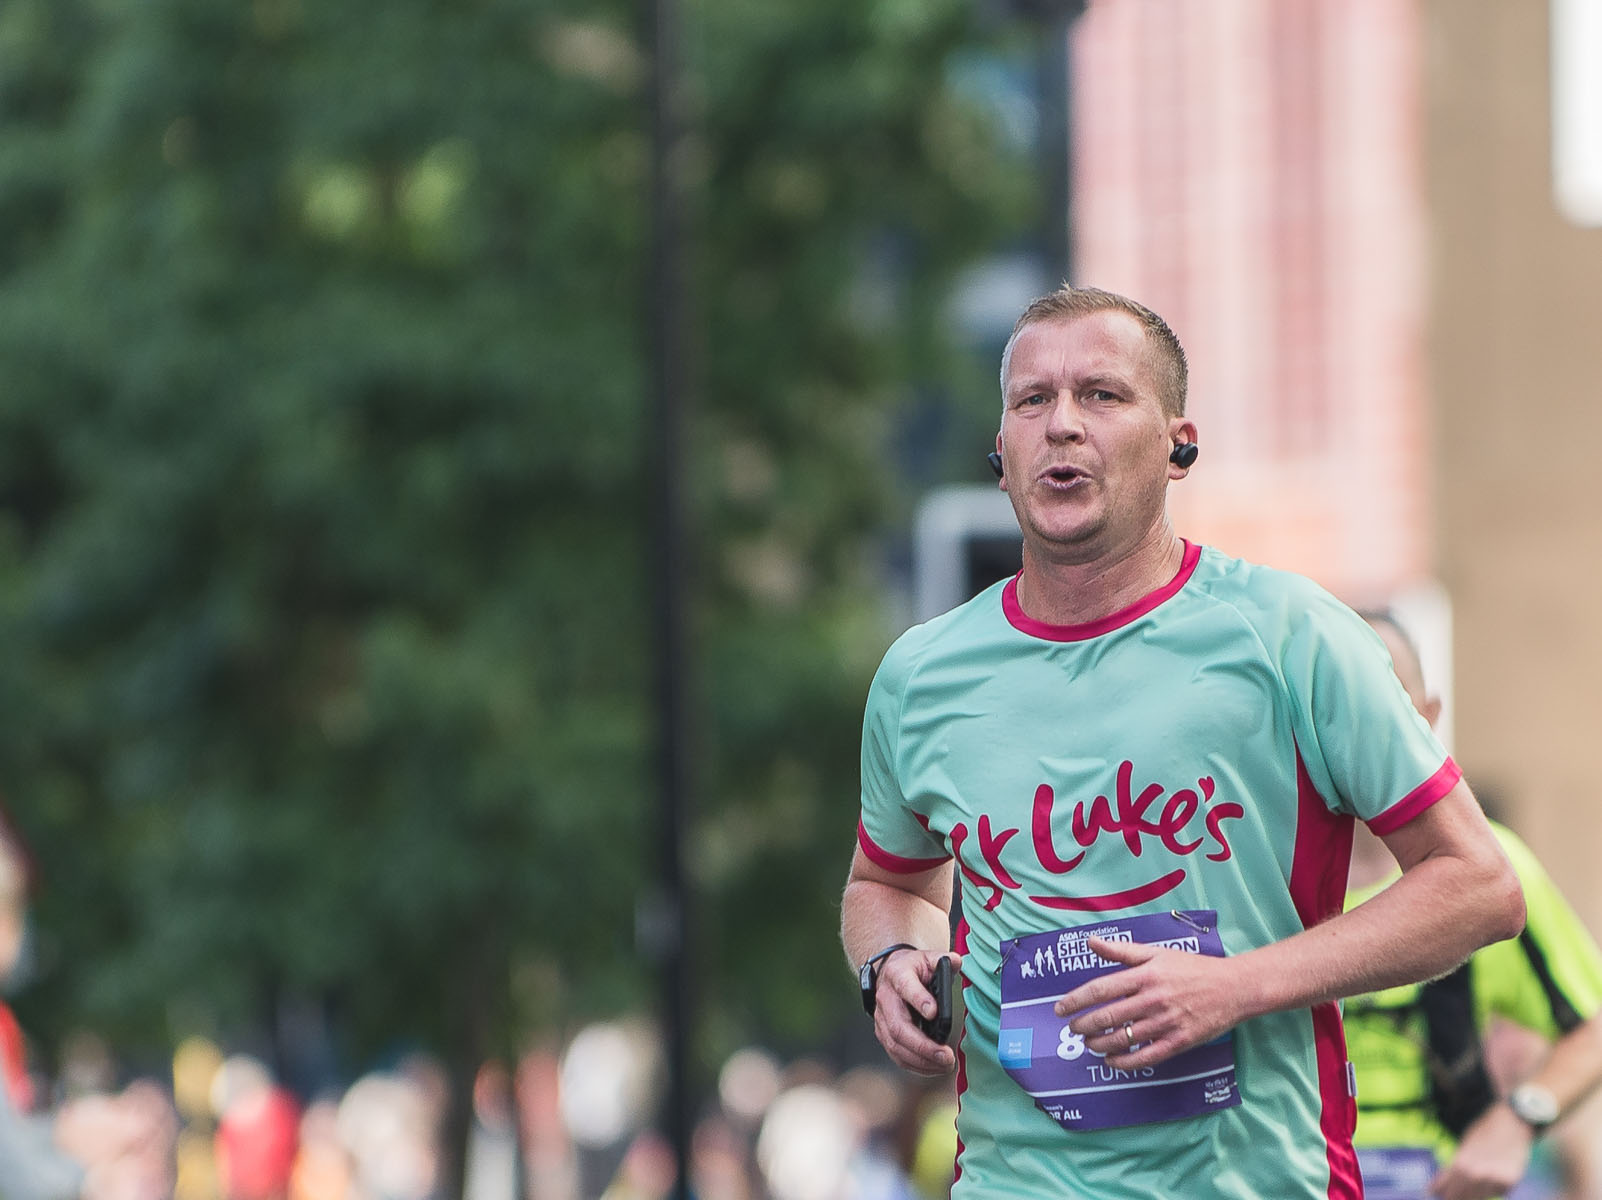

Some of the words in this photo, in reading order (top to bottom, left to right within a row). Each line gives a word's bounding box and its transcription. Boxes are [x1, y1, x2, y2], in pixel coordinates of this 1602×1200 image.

[1031, 759, 1245, 875] Luke's
[1058, 931, 1079, 943] ASDA
[1060, 953, 1098, 974] HALF
[1063, 1109, 1083, 1121] ALL
